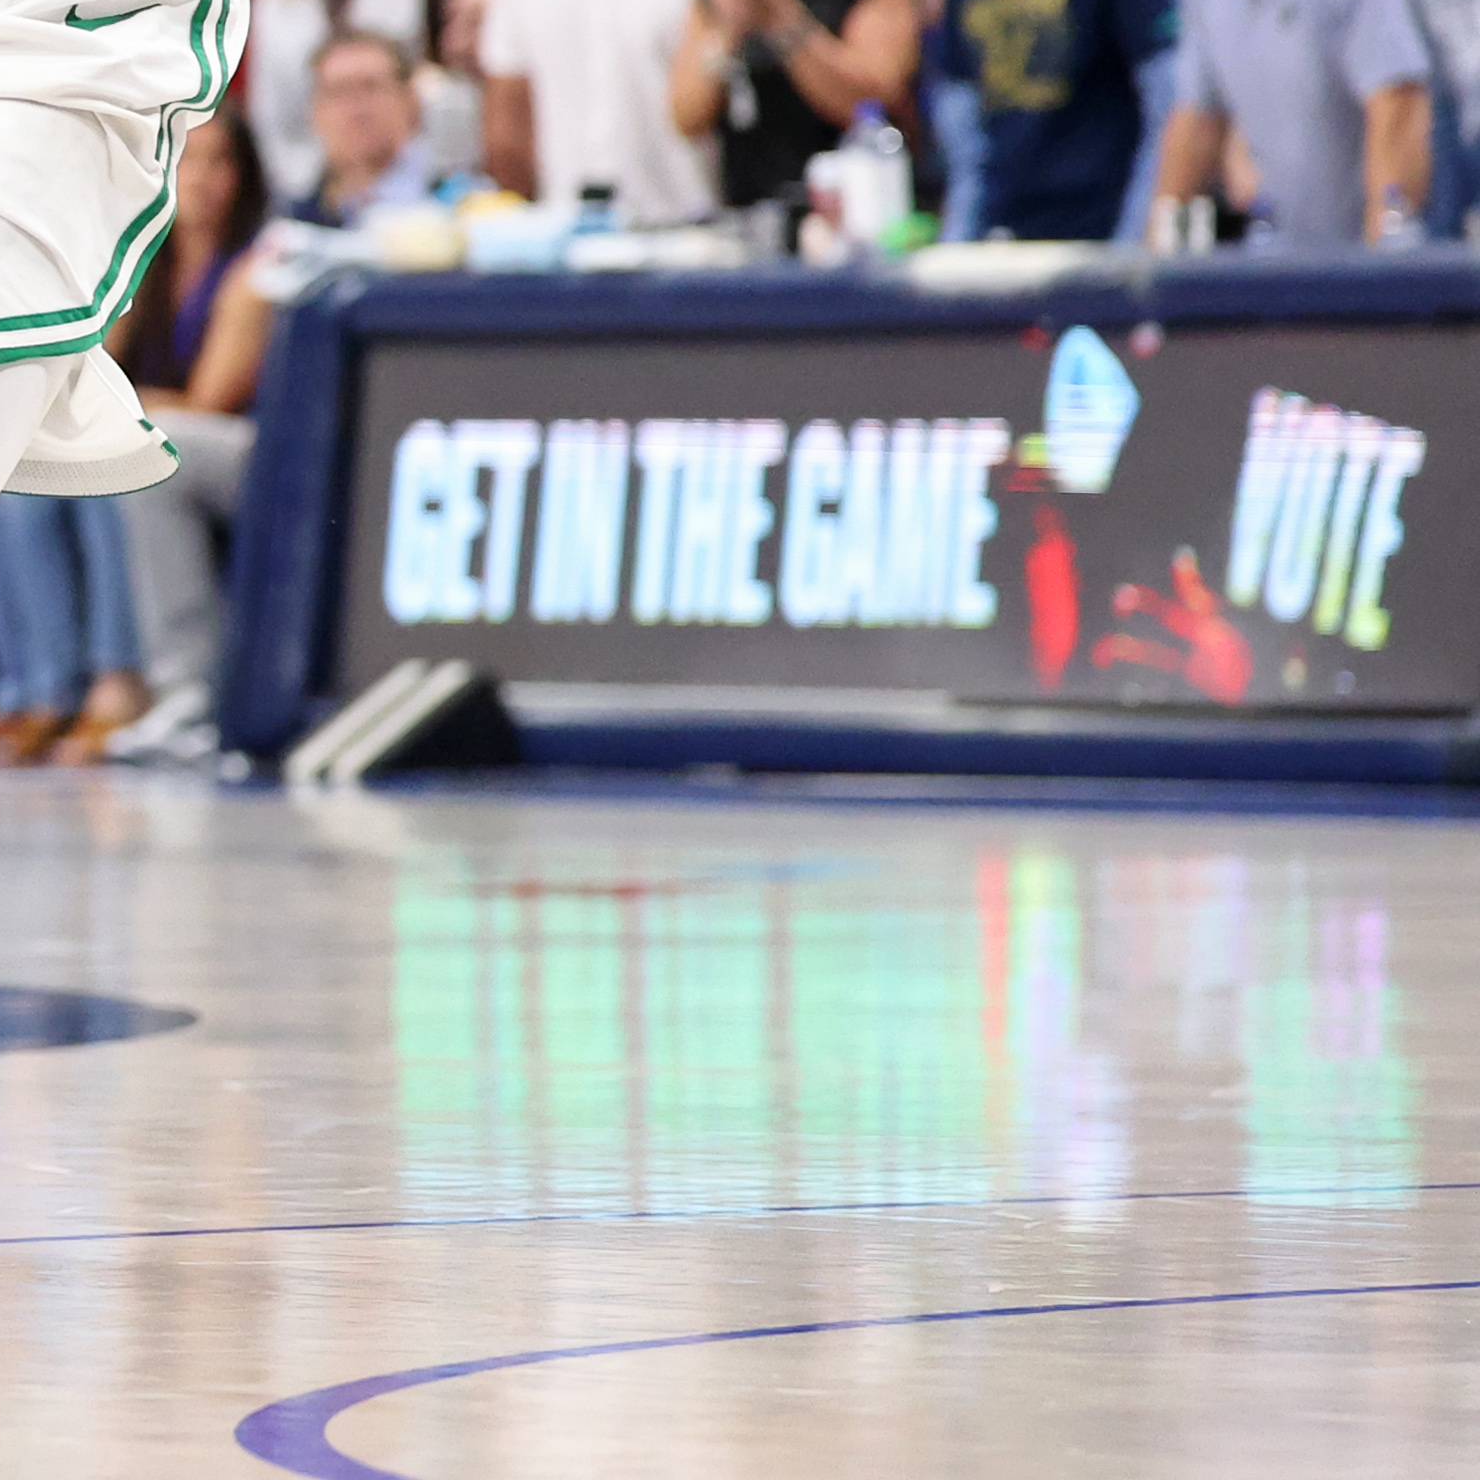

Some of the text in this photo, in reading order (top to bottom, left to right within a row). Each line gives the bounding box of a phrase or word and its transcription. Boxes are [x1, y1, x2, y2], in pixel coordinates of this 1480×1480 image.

[382, 417, 1011, 628] GET IN THE GAME
[1226, 385, 1427, 652] VOTE
